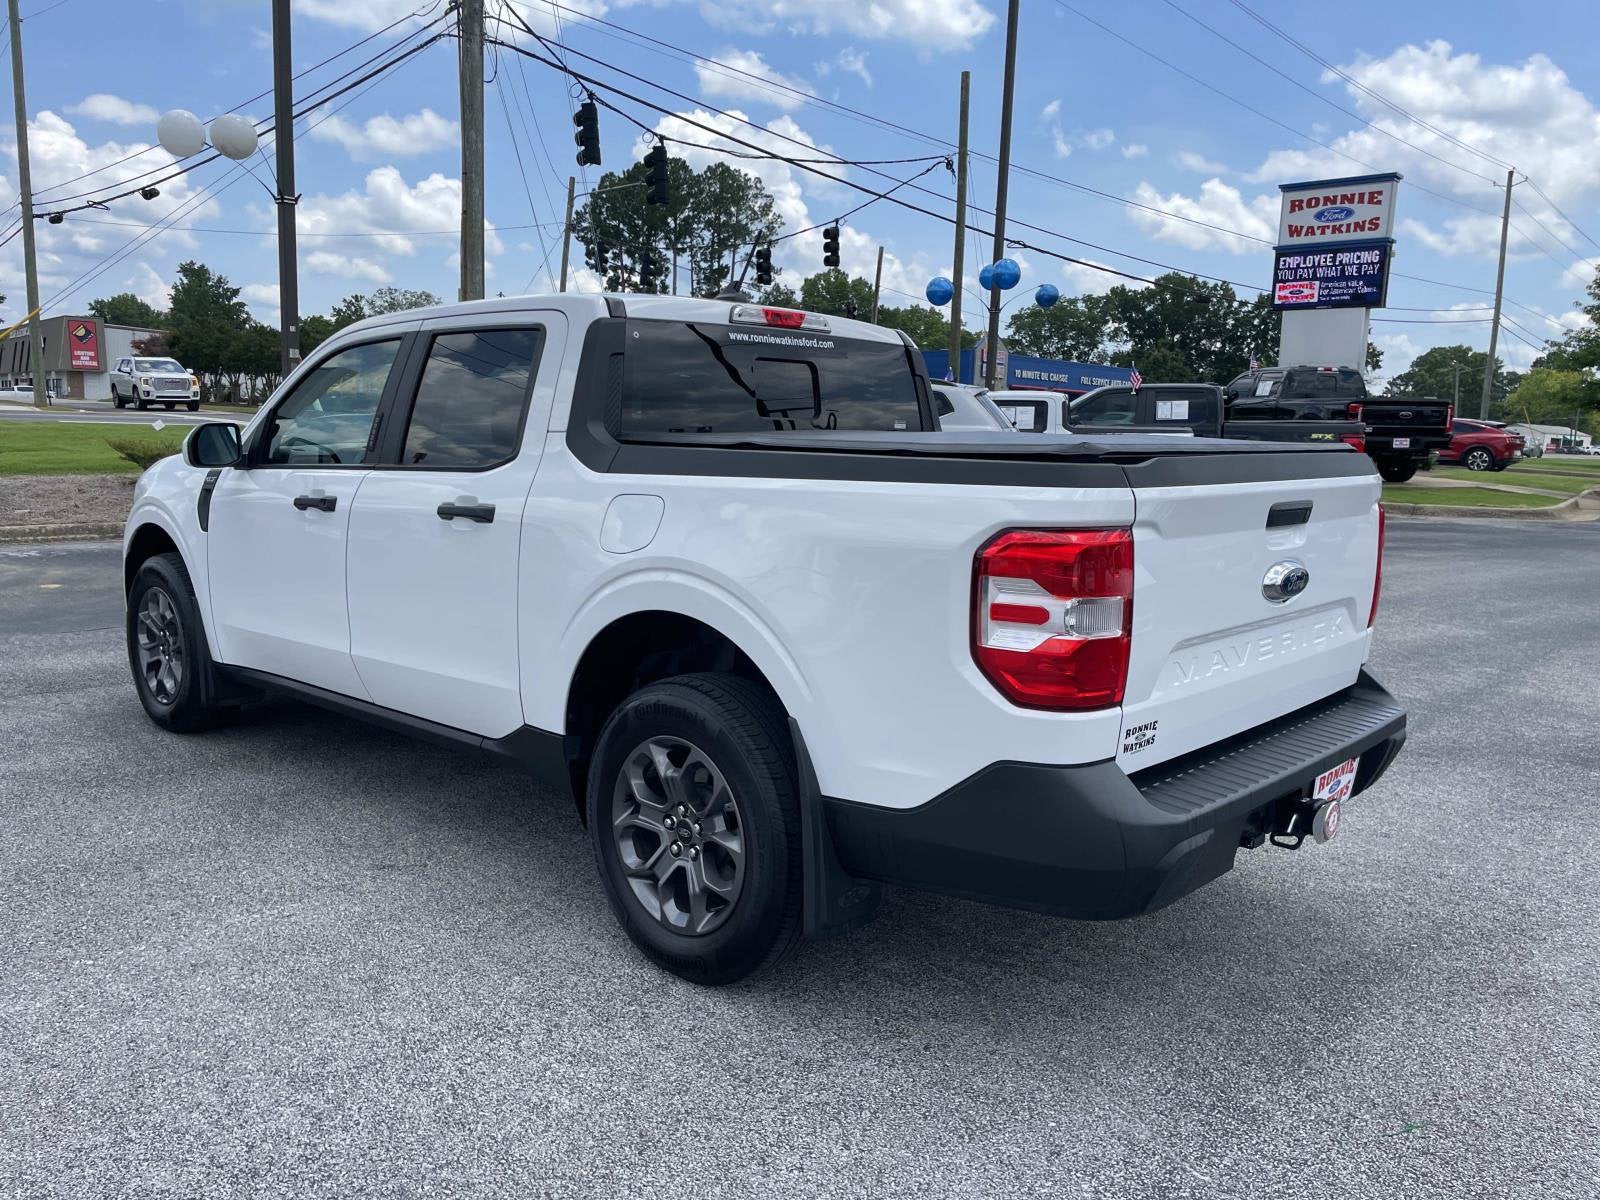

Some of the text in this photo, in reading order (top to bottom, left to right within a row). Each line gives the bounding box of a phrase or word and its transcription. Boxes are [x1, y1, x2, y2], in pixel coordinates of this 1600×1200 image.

[1289, 190, 1383, 213] RONNIE
[1321, 208, 1348, 221] Ford
[1287, 216, 1381, 238] WATKINS
[1279, 250, 1380, 268] EMPLOYEE PRICING
[1277, 263, 1380, 280] YOU PAY WHAT WE PAY
[1278, 282, 1316, 291] RONNIE
[728, 332, 835, 349] www.ronniewatkinsford.com
[1022, 370, 1040, 380] MINUTE
[1040, 372, 1049, 381] OIL
[1049, 373, 1069, 383] CHANGE
[1080, 376, 1091, 385] FULL
[1092, 378, 1110, 387] SERVICE
[1172, 615, 1344, 687] MAVERICK
[1125, 720, 1158, 740] RONNIE
[1123, 734, 1156, 754] WATKINS
[1318, 757, 1357, 796] RONNIE
